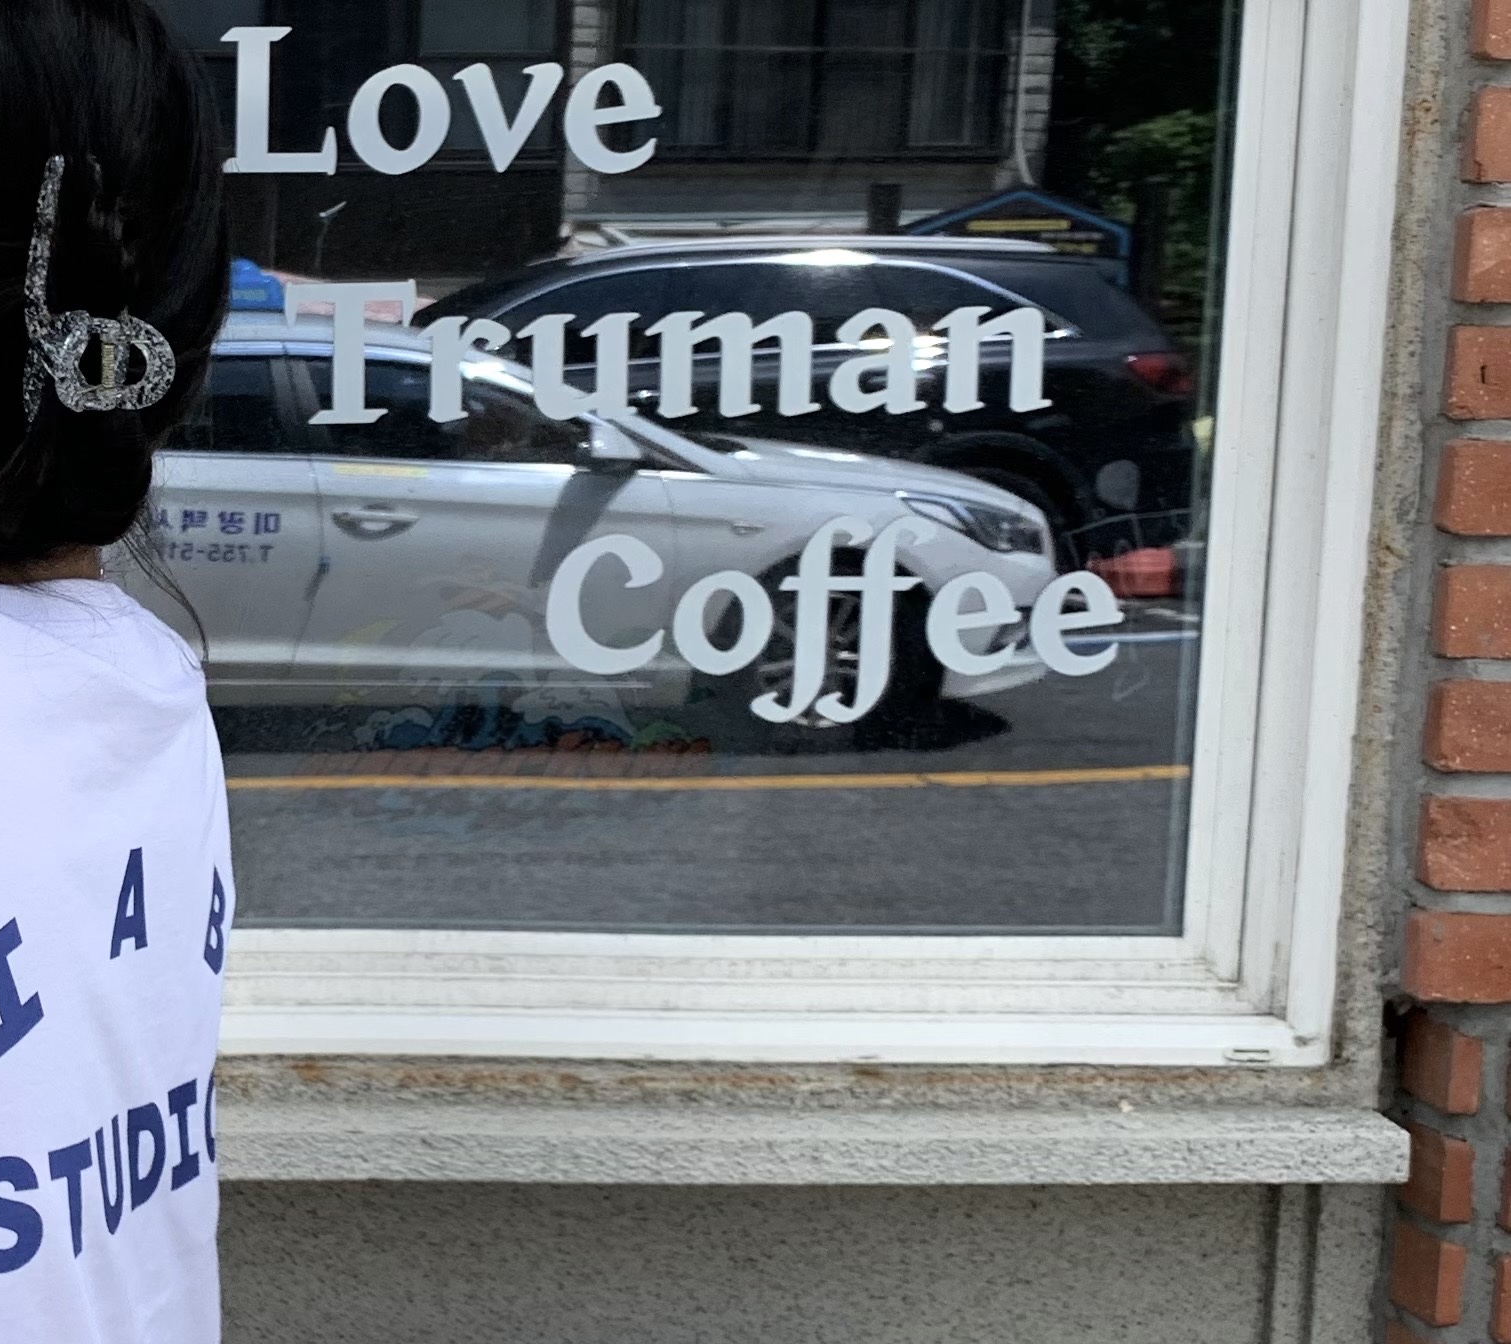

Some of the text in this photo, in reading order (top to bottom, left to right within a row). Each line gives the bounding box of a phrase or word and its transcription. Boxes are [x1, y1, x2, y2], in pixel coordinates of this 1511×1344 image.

[219, 25, 663, 176] Love
[283, 278, 1054, 425] Truman
[545, 515, 1125, 723] Coffee
